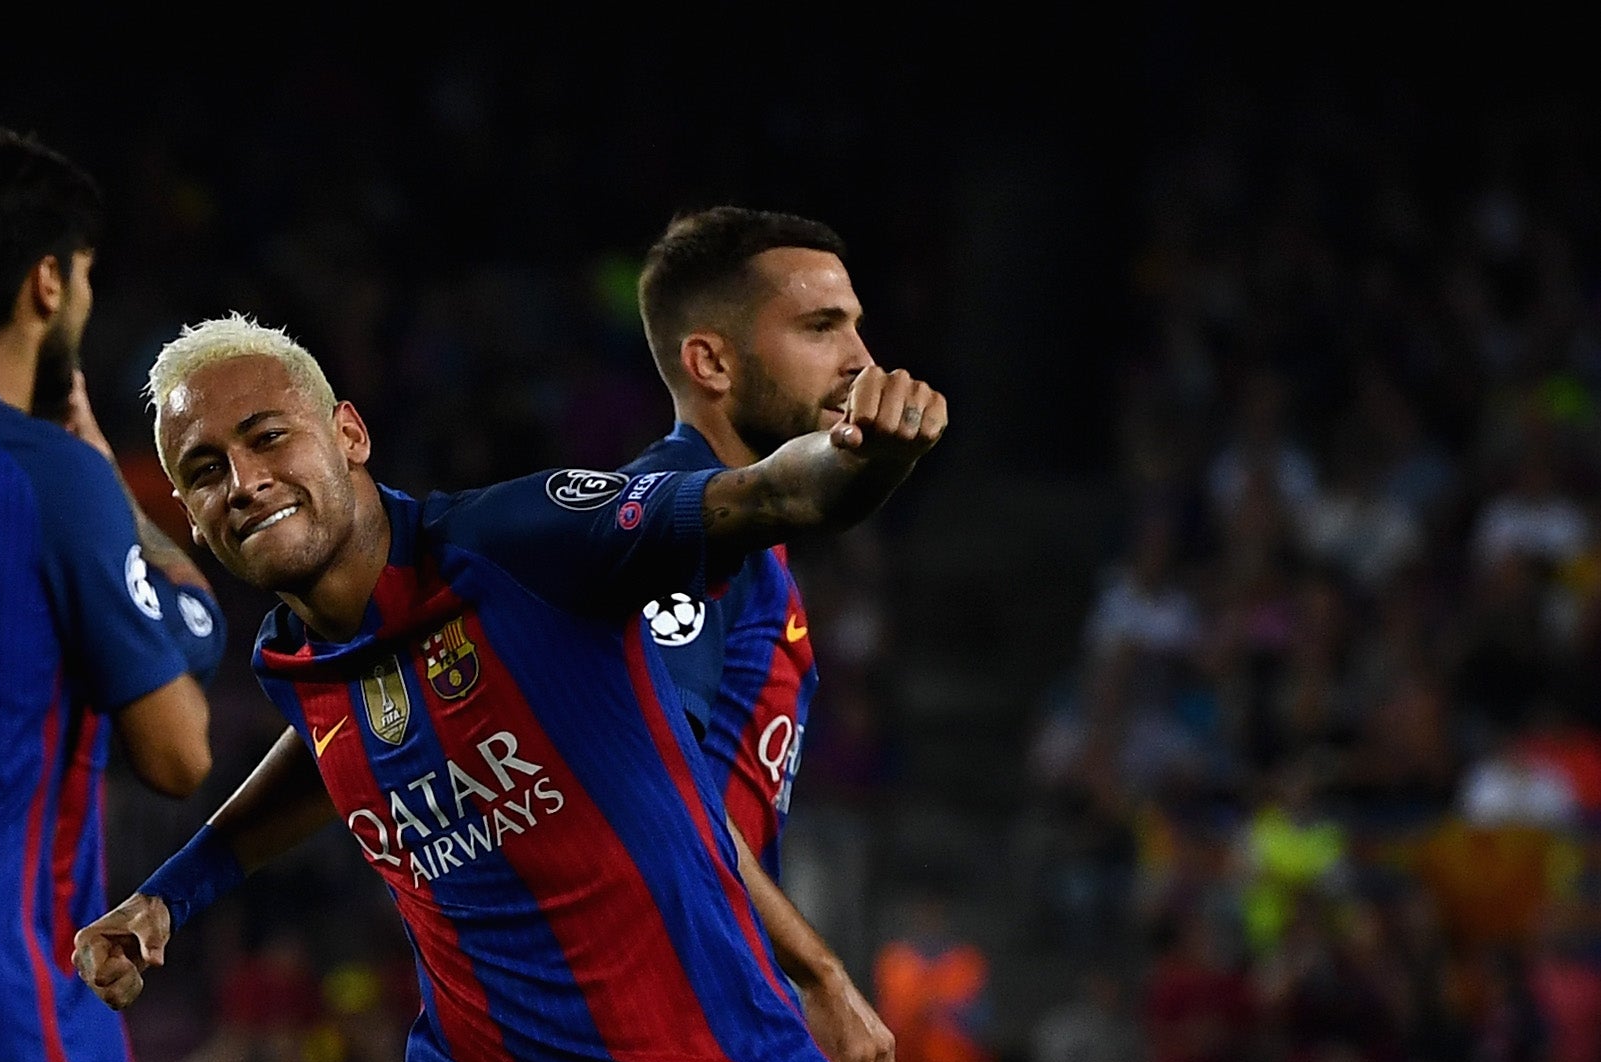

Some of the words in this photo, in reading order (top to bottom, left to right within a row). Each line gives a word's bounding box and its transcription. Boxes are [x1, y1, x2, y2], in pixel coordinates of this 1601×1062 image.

[380, 708, 401, 727] FIFA
[348, 731, 543, 867] QATAR
[410, 777, 564, 889] AIRWAYS
